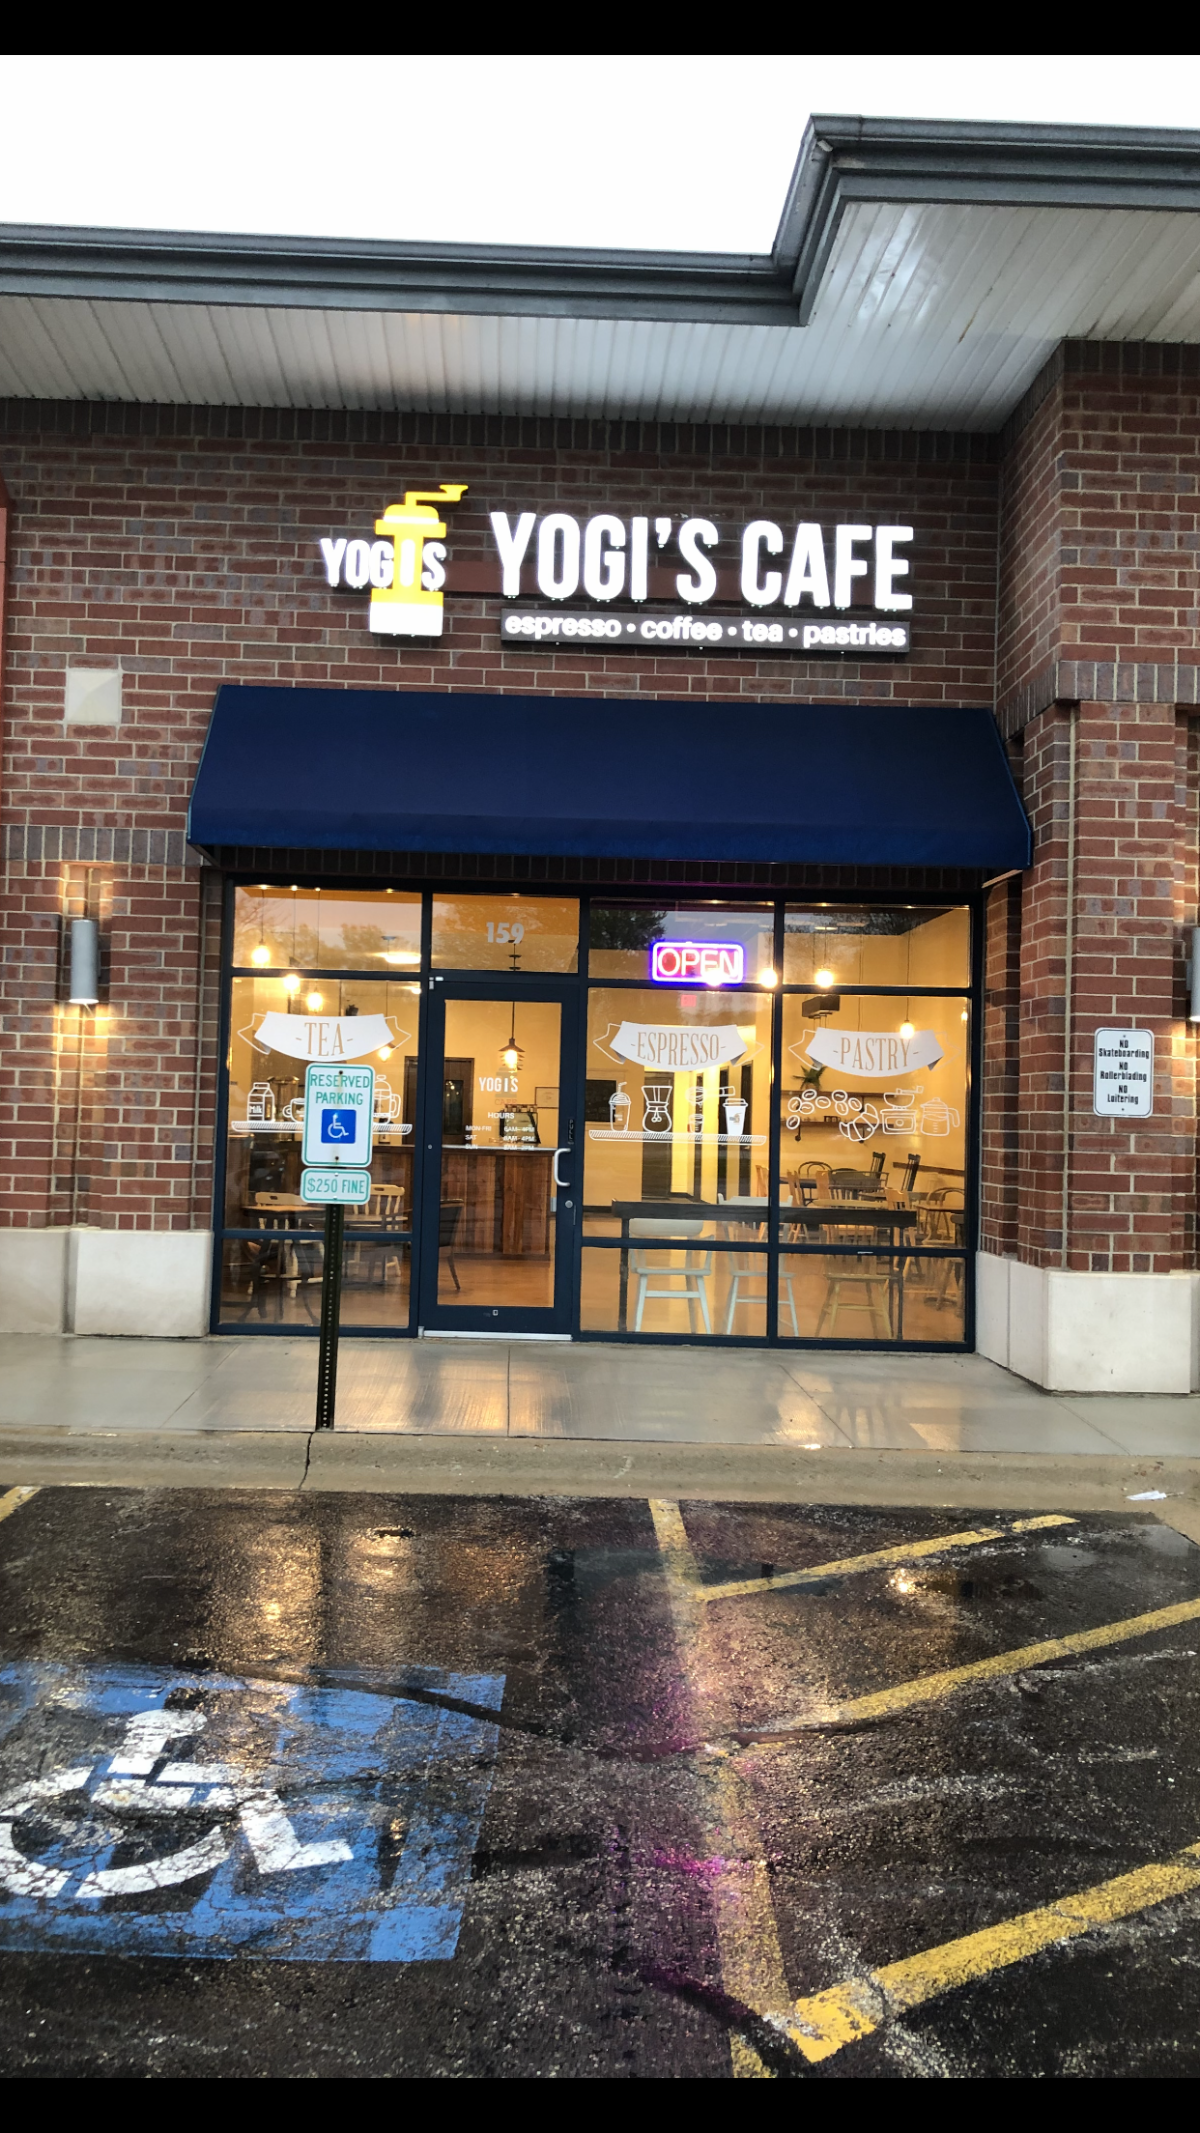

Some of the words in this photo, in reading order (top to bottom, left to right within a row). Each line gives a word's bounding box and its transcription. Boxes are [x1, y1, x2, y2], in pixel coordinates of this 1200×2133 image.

[320, 538, 447, 590] YOGIS
[490, 511, 719, 604] YOGI'S
[740, 520, 914, 611] CAFE
[505, 614, 622, 640] espresso
[640, 616, 723, 641] coffee
[742, 621, 783, 643] tea
[803, 622, 907, 649] pastries
[486, 921, 525, 944] 159
[657, 947, 740, 979] OPEN
[1119, 1039, 1129, 1049] NO
[1098, 1048, 1150, 1060] Skateboarding
[1119, 1061, 1129, 1071] NO
[309, 1073, 370, 1089] RESERVED
[1100, 1071, 1147, 1082] Rollerblading
[478, 1076, 519, 1093] YOGIS
[1118, 1084, 1128, 1094] NO
[315, 1091, 364, 1106] PARKING
[1107, 1093, 1139, 1105] Loitering
[249, 1105, 263, 1114] Milk
[306, 1178, 338, 1194] $250
[341, 1179, 366, 1195] FINE
